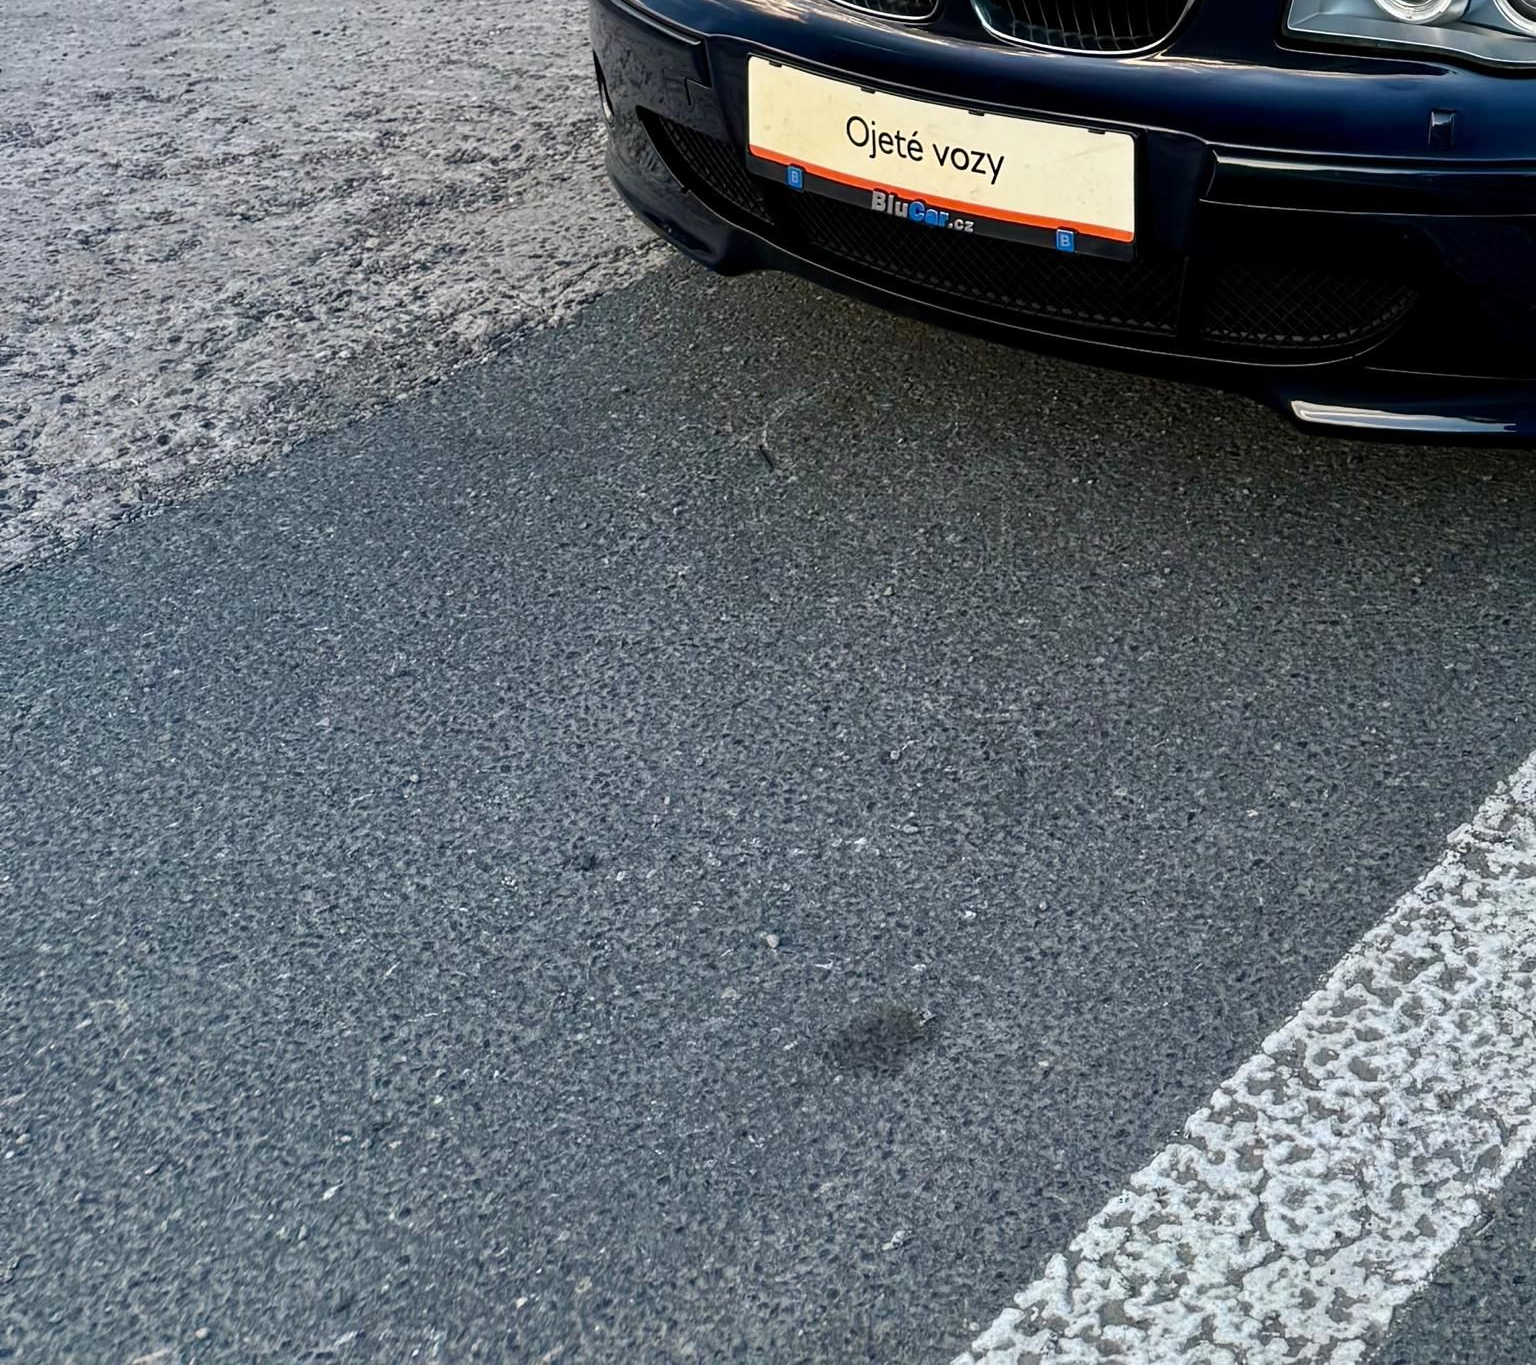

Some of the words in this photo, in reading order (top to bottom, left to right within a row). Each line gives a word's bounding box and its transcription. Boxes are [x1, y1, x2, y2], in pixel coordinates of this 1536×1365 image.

[846, 115, 924, 163] Ojeté
[932, 141, 1005, 185] vozy
[871, 189, 975, 233] BluCar.cz
